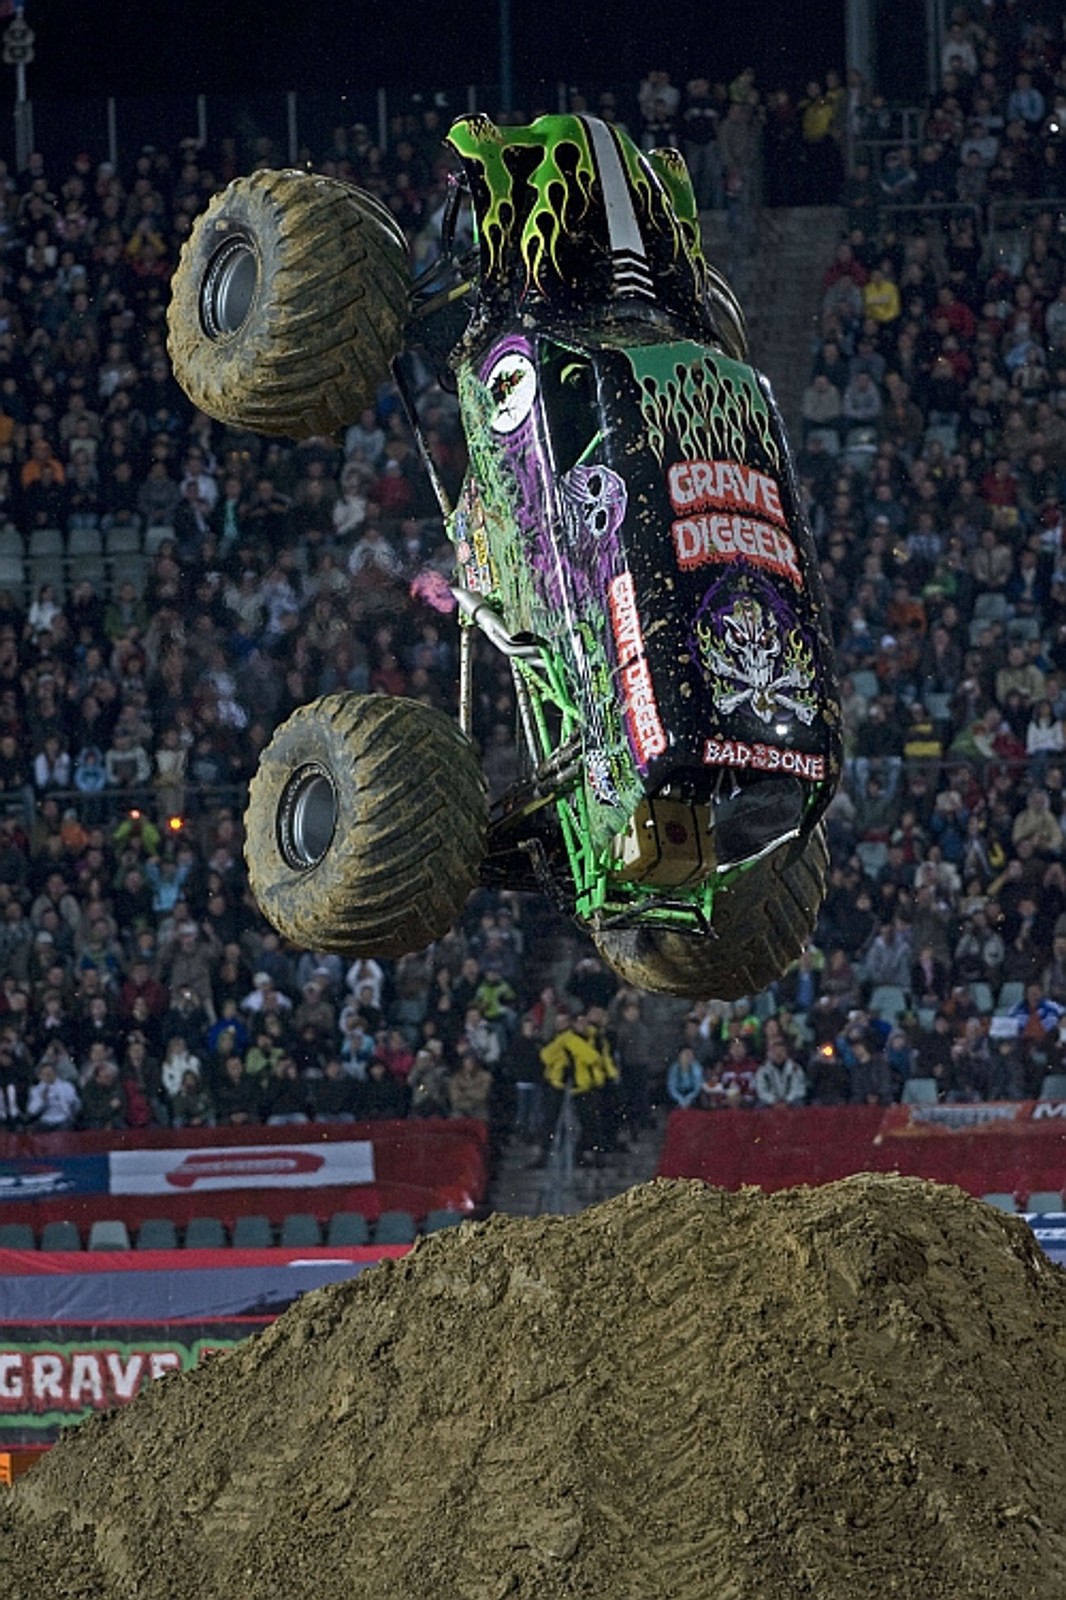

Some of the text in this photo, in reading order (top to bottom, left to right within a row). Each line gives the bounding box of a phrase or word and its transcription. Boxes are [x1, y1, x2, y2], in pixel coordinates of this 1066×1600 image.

[668, 460, 784, 519] GRAVE
[675, 515, 802, 584] DIGGER
[625, 658, 666, 764] DIGGER
[705, 741, 750, 765] BAD
[767, 748, 823, 779] BONE
